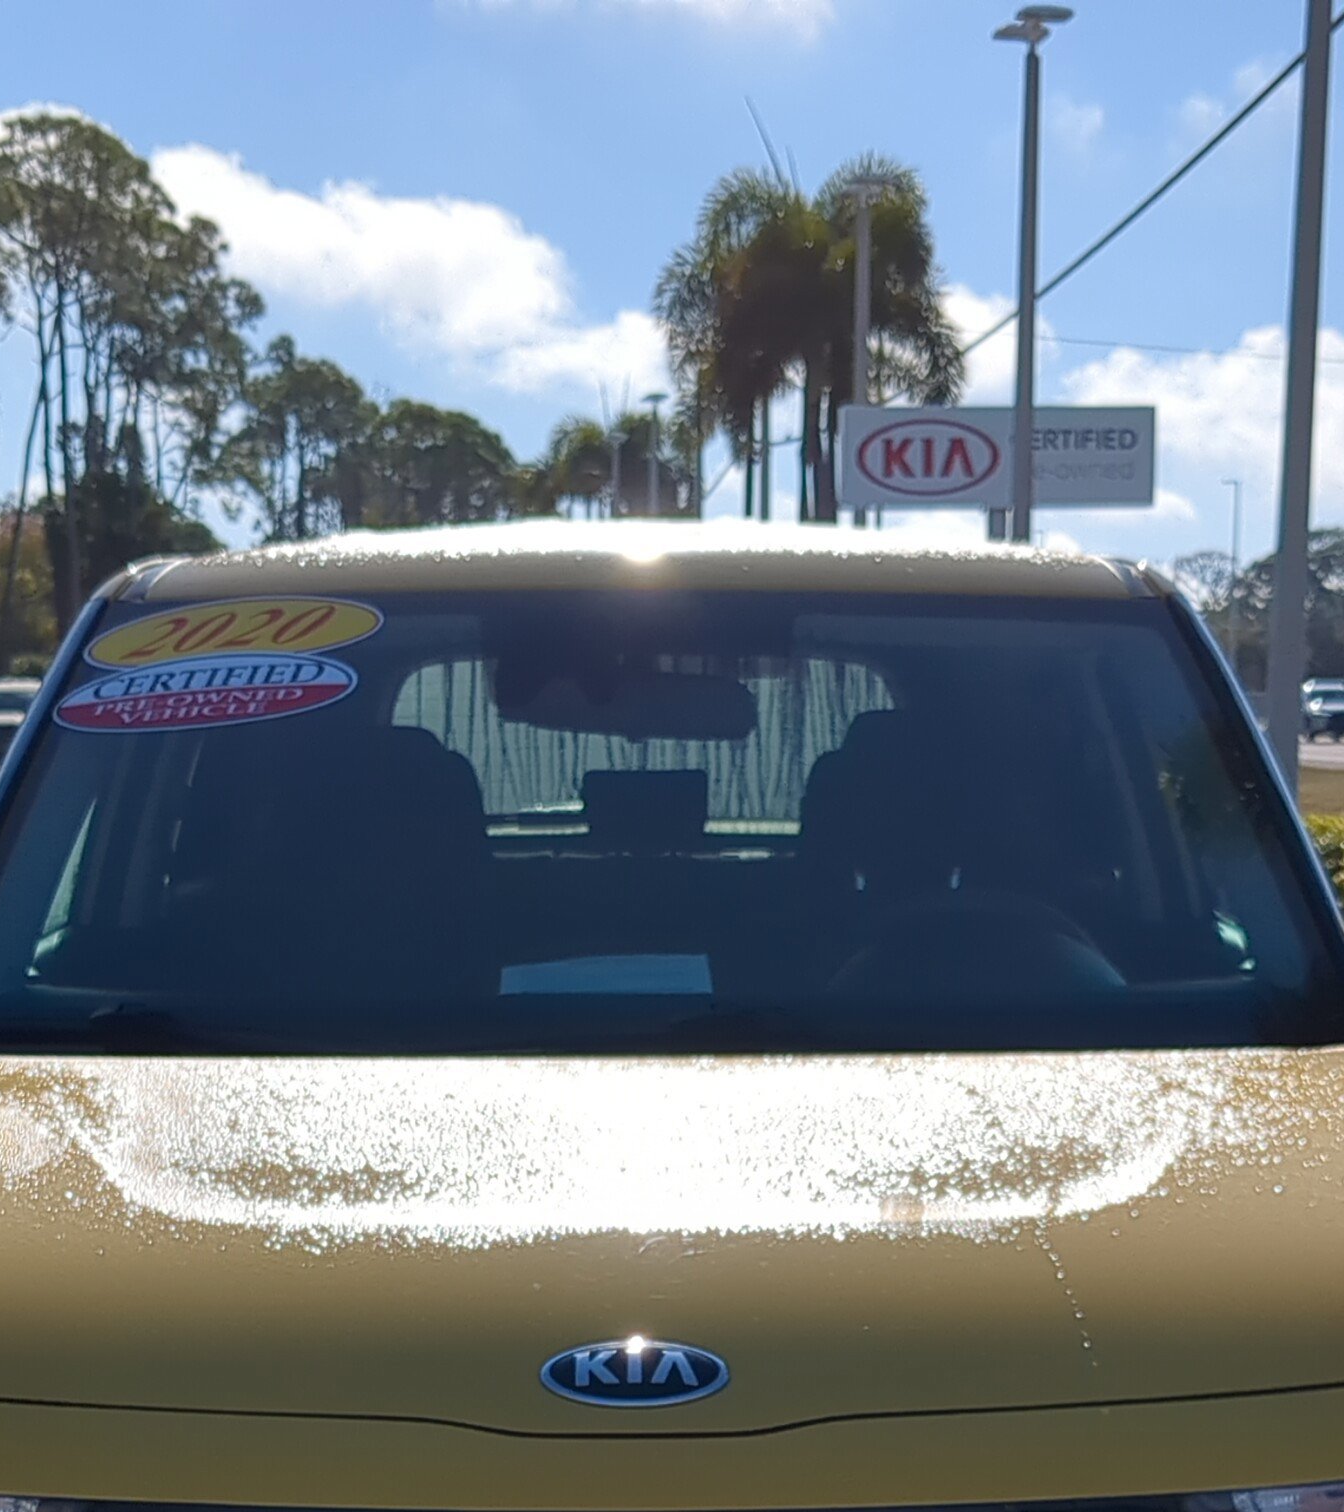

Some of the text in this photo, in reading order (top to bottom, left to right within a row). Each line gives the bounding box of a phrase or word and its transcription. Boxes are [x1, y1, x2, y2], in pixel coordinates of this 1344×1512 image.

[1009, 427, 1138, 451] ERTIFIED
[881, 437, 974, 479] KIA
[119, 605, 336, 660] 2020
[93, 662, 325, 700] CERTIFIED
[94, 687, 304, 717] PRE-OWNED
[120, 701, 269, 725] VEHICLE
[572, 1350, 699, 1387] KIA
